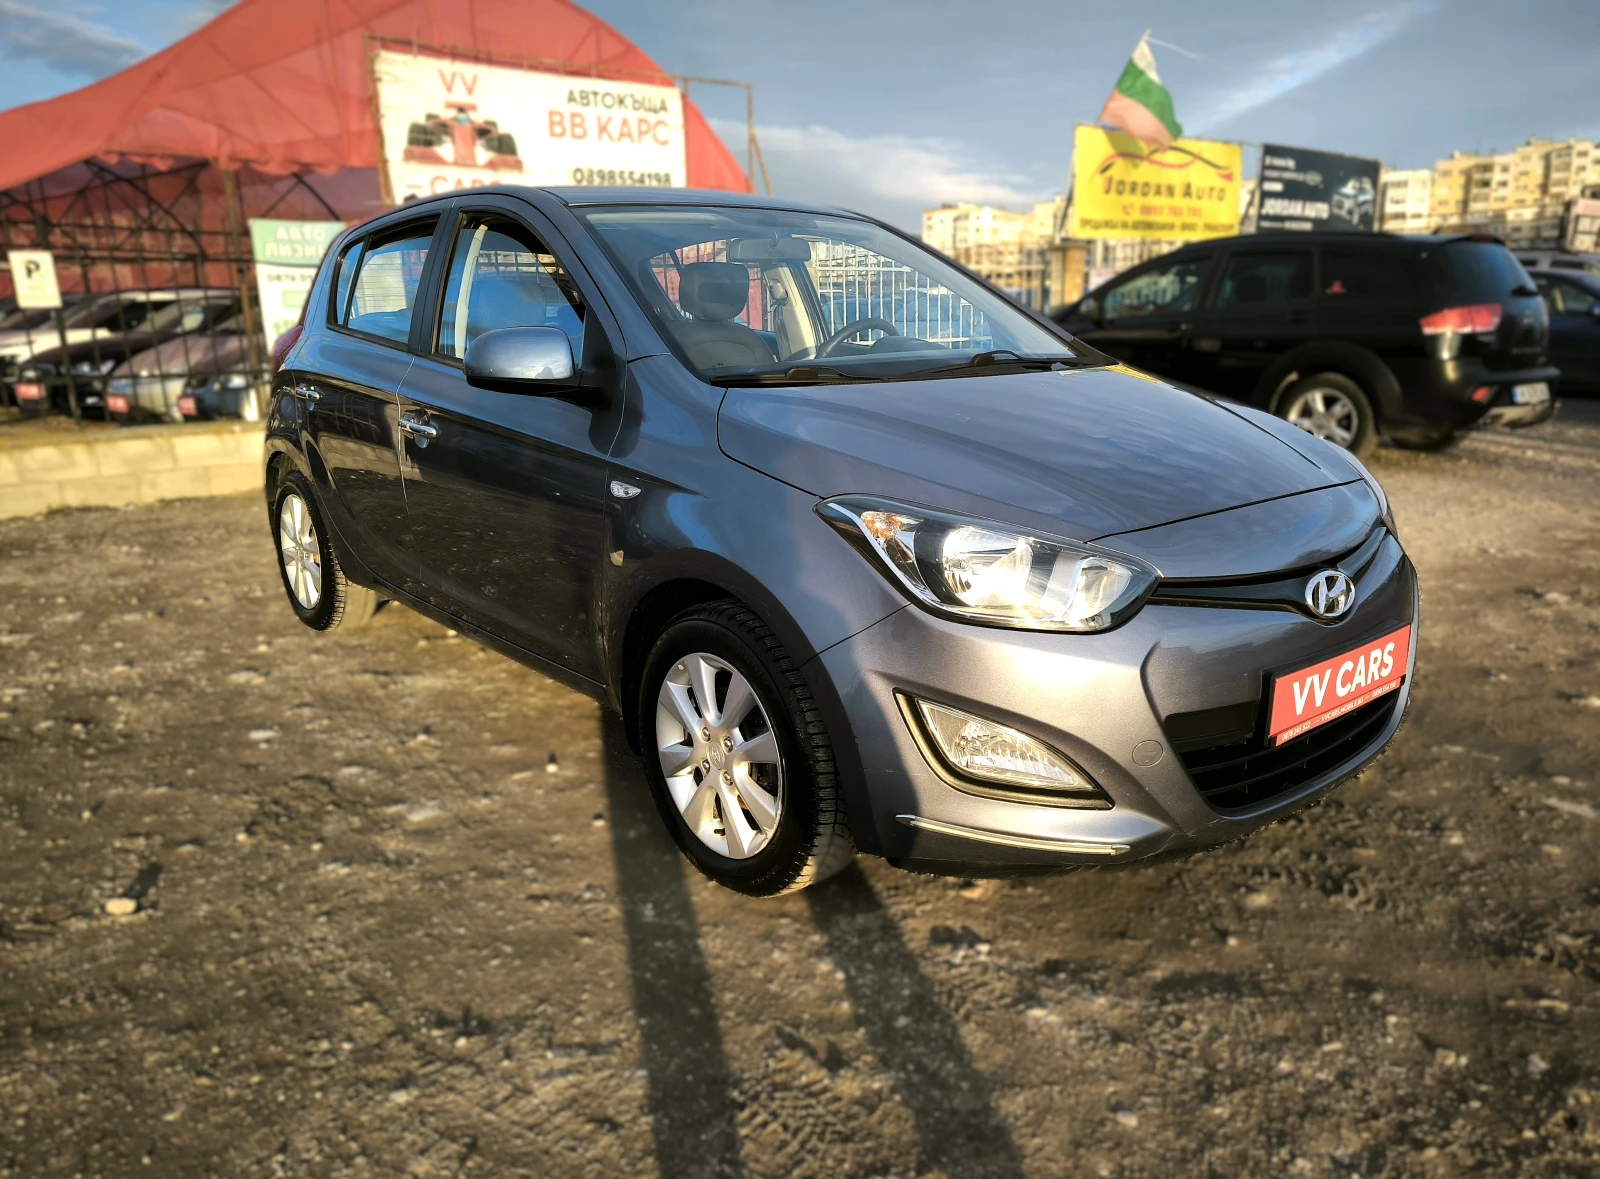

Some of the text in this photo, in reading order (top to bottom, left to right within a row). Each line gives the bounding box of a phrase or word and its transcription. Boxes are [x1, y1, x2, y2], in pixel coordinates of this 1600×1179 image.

[438, 68, 477, 96] VV
[567, 88, 669, 114] АВТОКЪЩА
[548, 109, 669, 146] ВВ КАРС
[276, 227, 325, 242] АВТО
[1292, 642, 1395, 716] VV CARS
